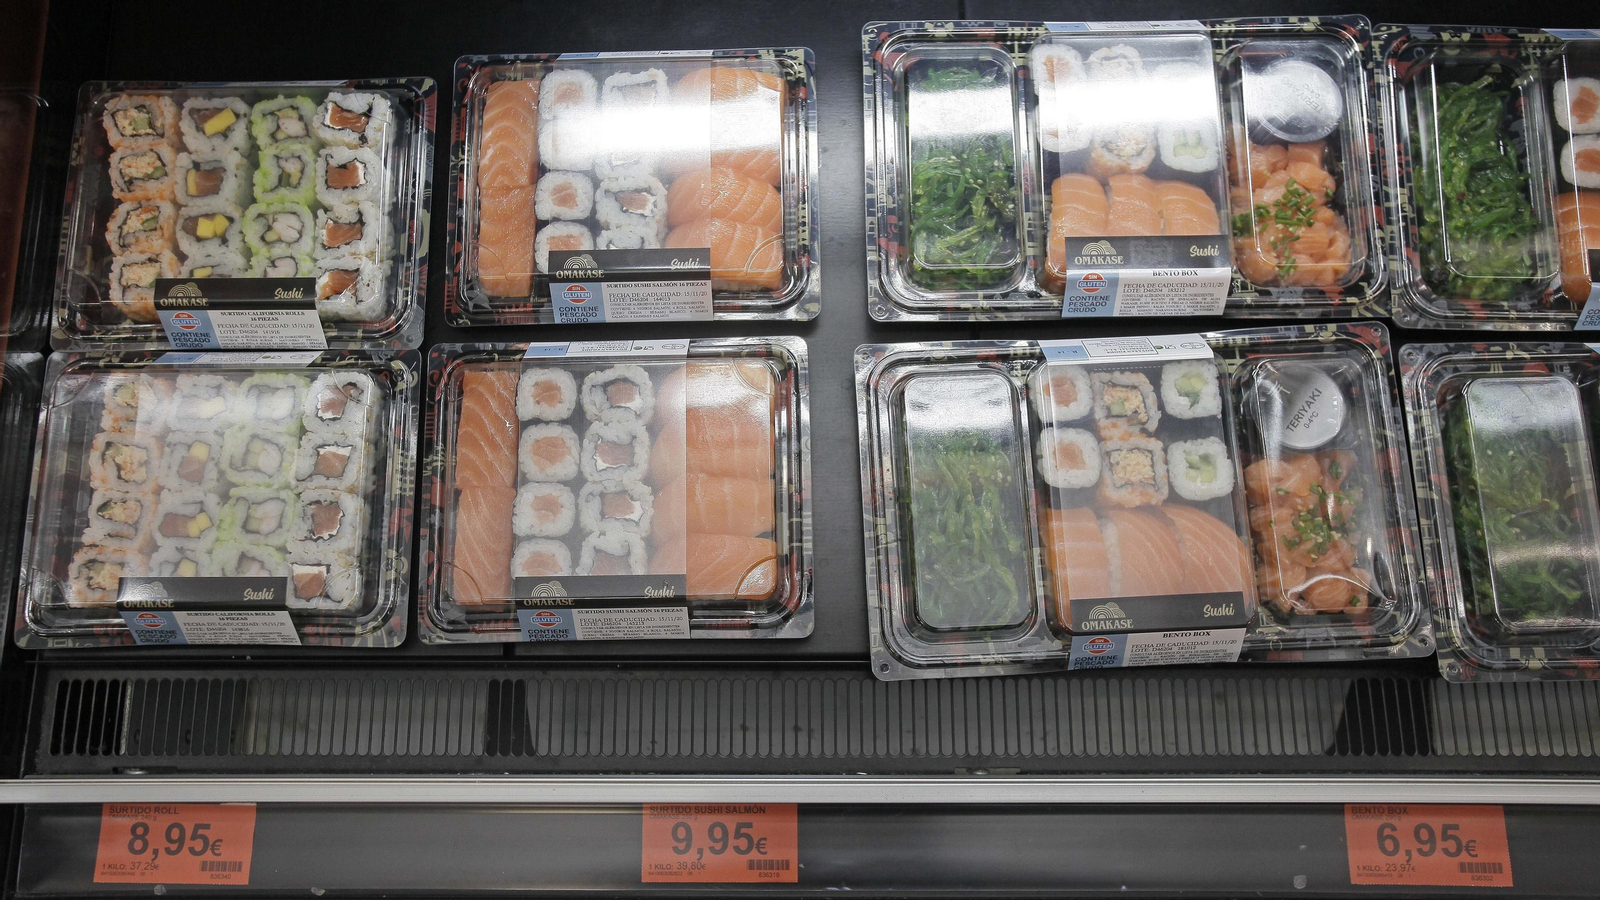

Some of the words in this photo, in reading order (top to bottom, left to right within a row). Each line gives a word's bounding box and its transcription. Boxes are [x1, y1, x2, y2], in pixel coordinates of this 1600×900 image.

[1190, 244, 1220, 257] Sushi
[671, 258, 699, 270] Sushi
[1074, 256, 1124, 265] OMAKASE
[556, 270, 604, 278] OMAKASE
[274, 288, 304, 300] Sushi
[160, 297, 208, 306] OMAKASE
[1286, 388, 1322, 432] TERIYAKI
[244, 588, 274, 600] Sushi
[644, 586, 675, 598] Sushi
[124, 599, 174, 608] OMAKASE
[1203, 603, 1235, 617] Sushi
[1082, 619, 1134, 630] OMAKASE
[109, 806, 151, 814] SURTIDO
[154, 806, 179, 814] ROLL
[726, 804, 766, 814] SALMÓN
[1351, 806, 1385, 814] BENTO
[1388, 806, 1409, 815] BOX
[128, 822, 223, 862] 8,95€
[671, 822, 767, 861] 9,95€
[1377, 822, 1478, 863] 6,95€
[677, 862, 706, 870] 39,80€
[1386, 863, 1416, 872] 23,97€
